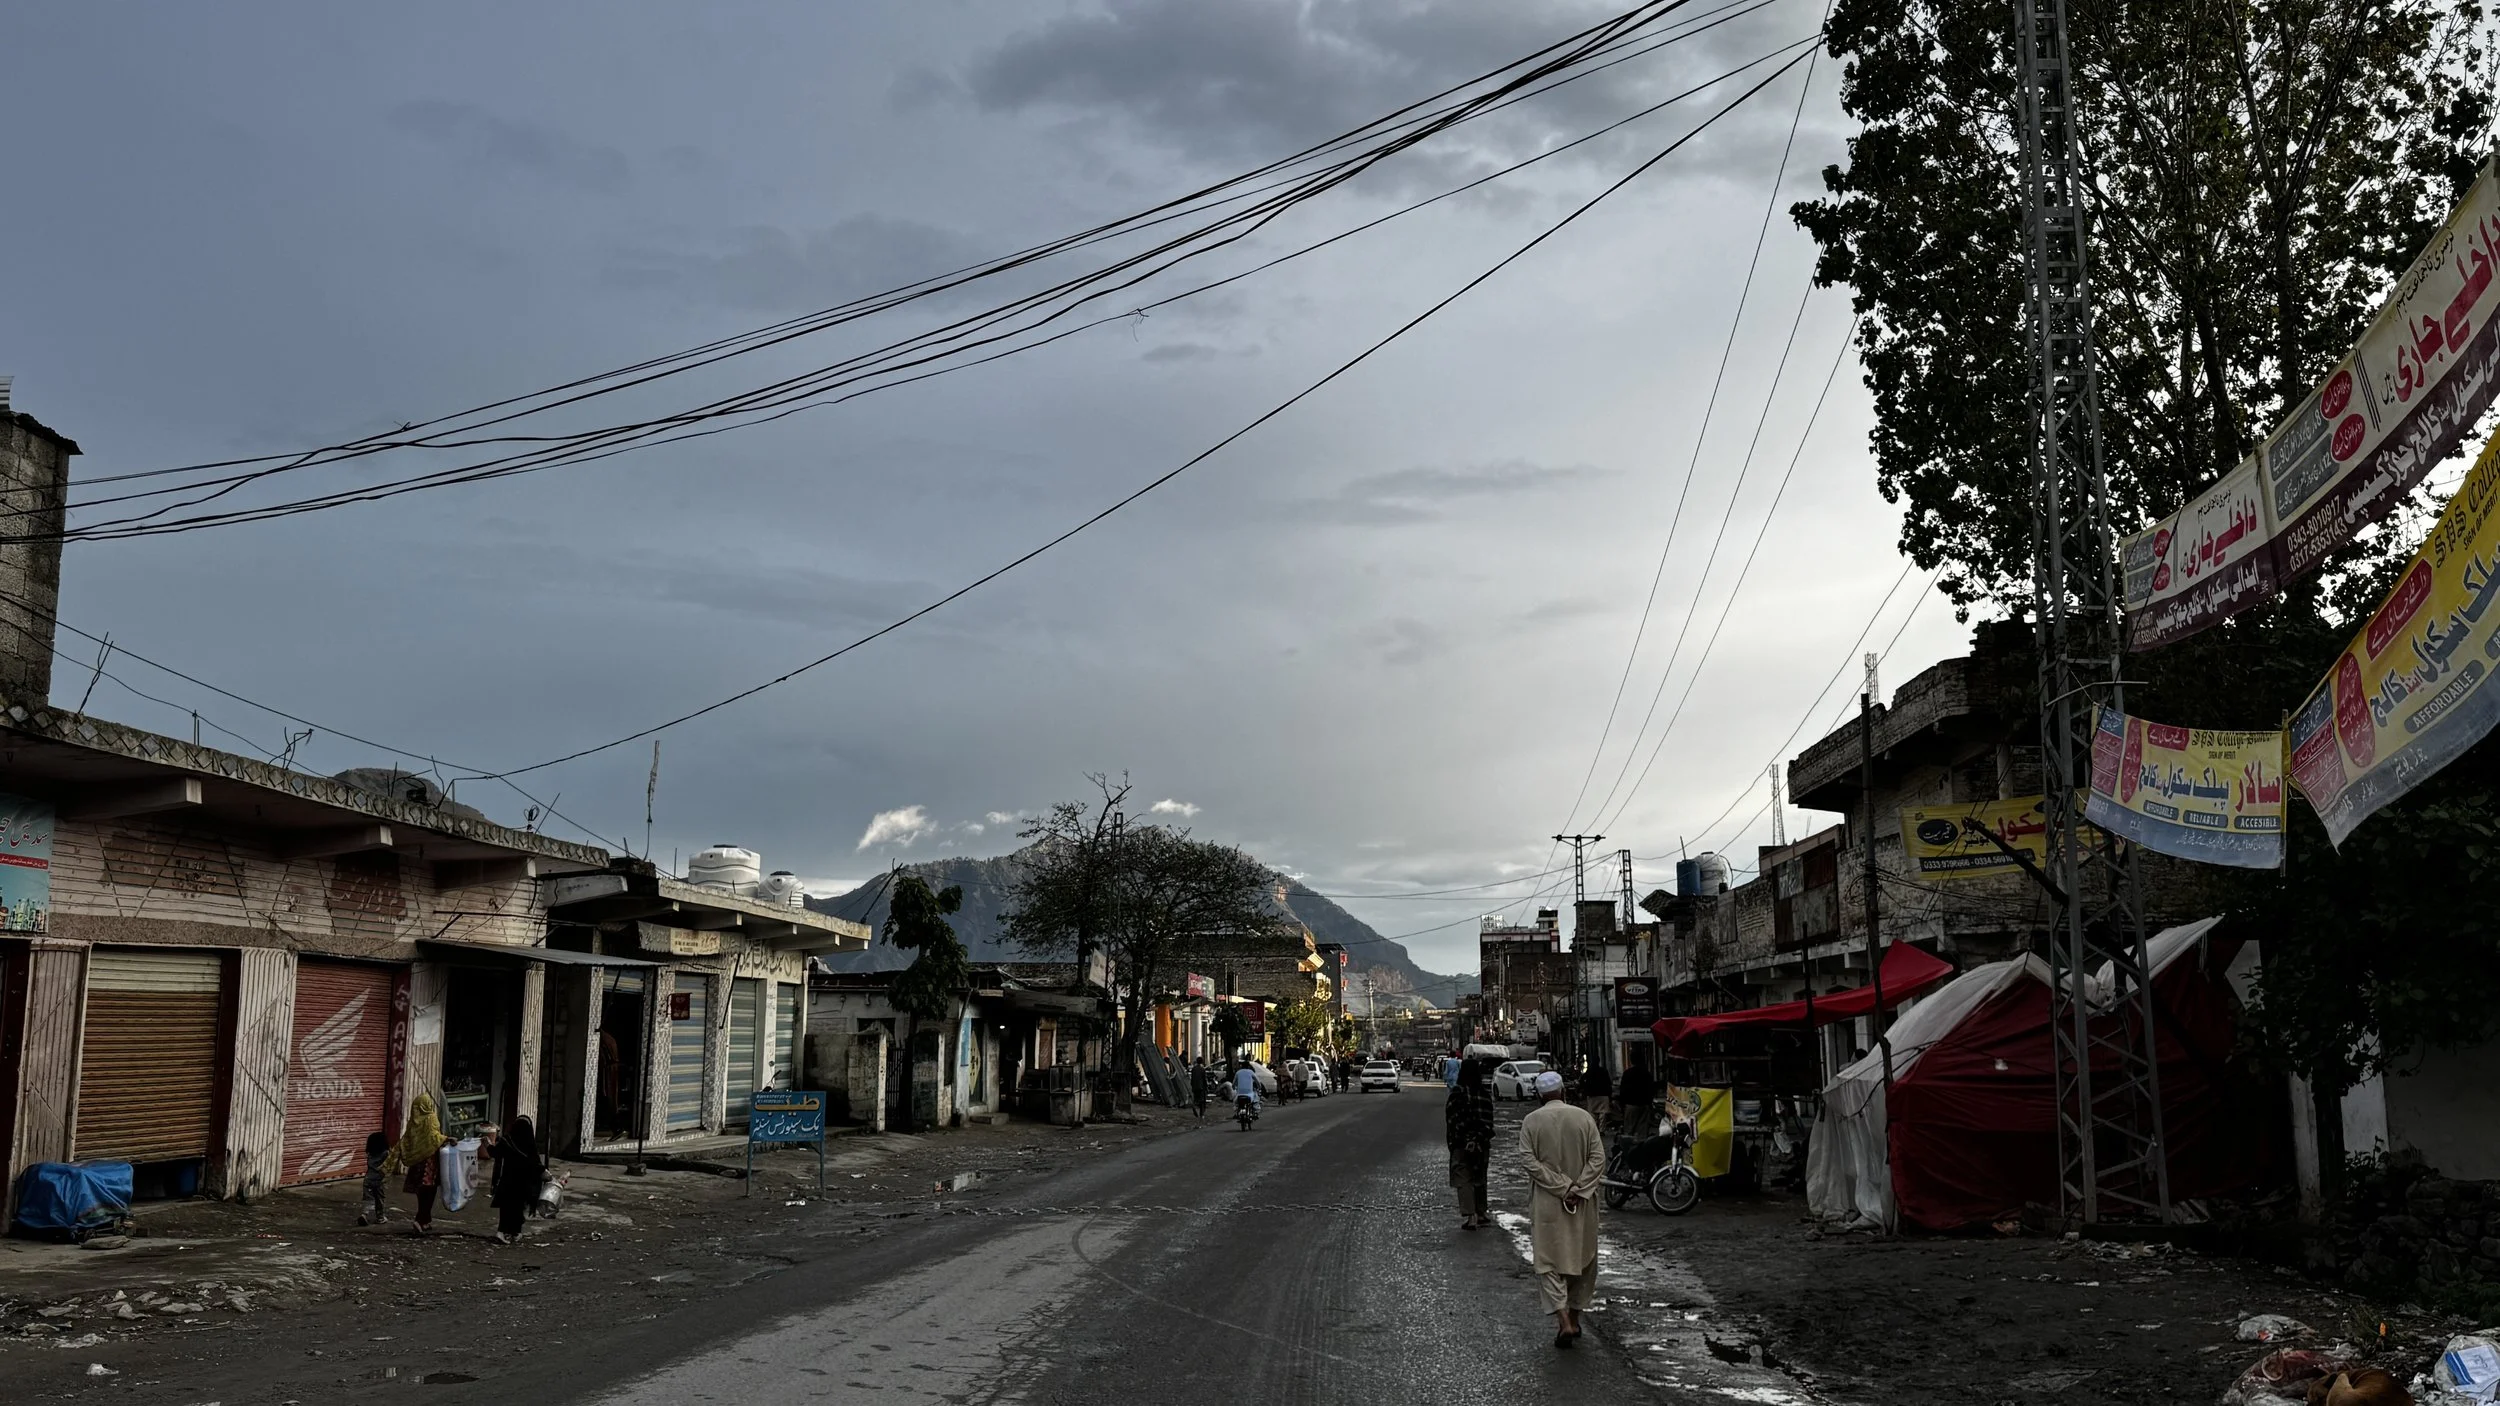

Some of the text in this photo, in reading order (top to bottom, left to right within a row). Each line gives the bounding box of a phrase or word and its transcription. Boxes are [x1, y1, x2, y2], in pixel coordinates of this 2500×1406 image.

[2394, 315, 2443, 403] جاری
[2409, 403, 2443, 465] کالج
[2213, 493, 2257, 567] داخلے
[2287, 494, 2341, 553] 0343-8010917
[2434, 504, 2467, 569] SPS
[2463, 525, 2477, 551] SIGN
[2482, 487, 2499, 517] MERIT
[2186, 525, 2214, 578] جاری
[2413, 614, 2471, 683] سکول
[2369, 669, 2409, 728] کالج
[2413, 672, 2475, 728] AFFORDABLE
[2162, 761, 2193, 800] سکول
[2193, 767, 2229, 811] پبلک
[2235, 760, 2281, 813] سالار
[2189, 813, 2220, 827] RELIABLE
[296, 1079, 365, 1099] HONDA
